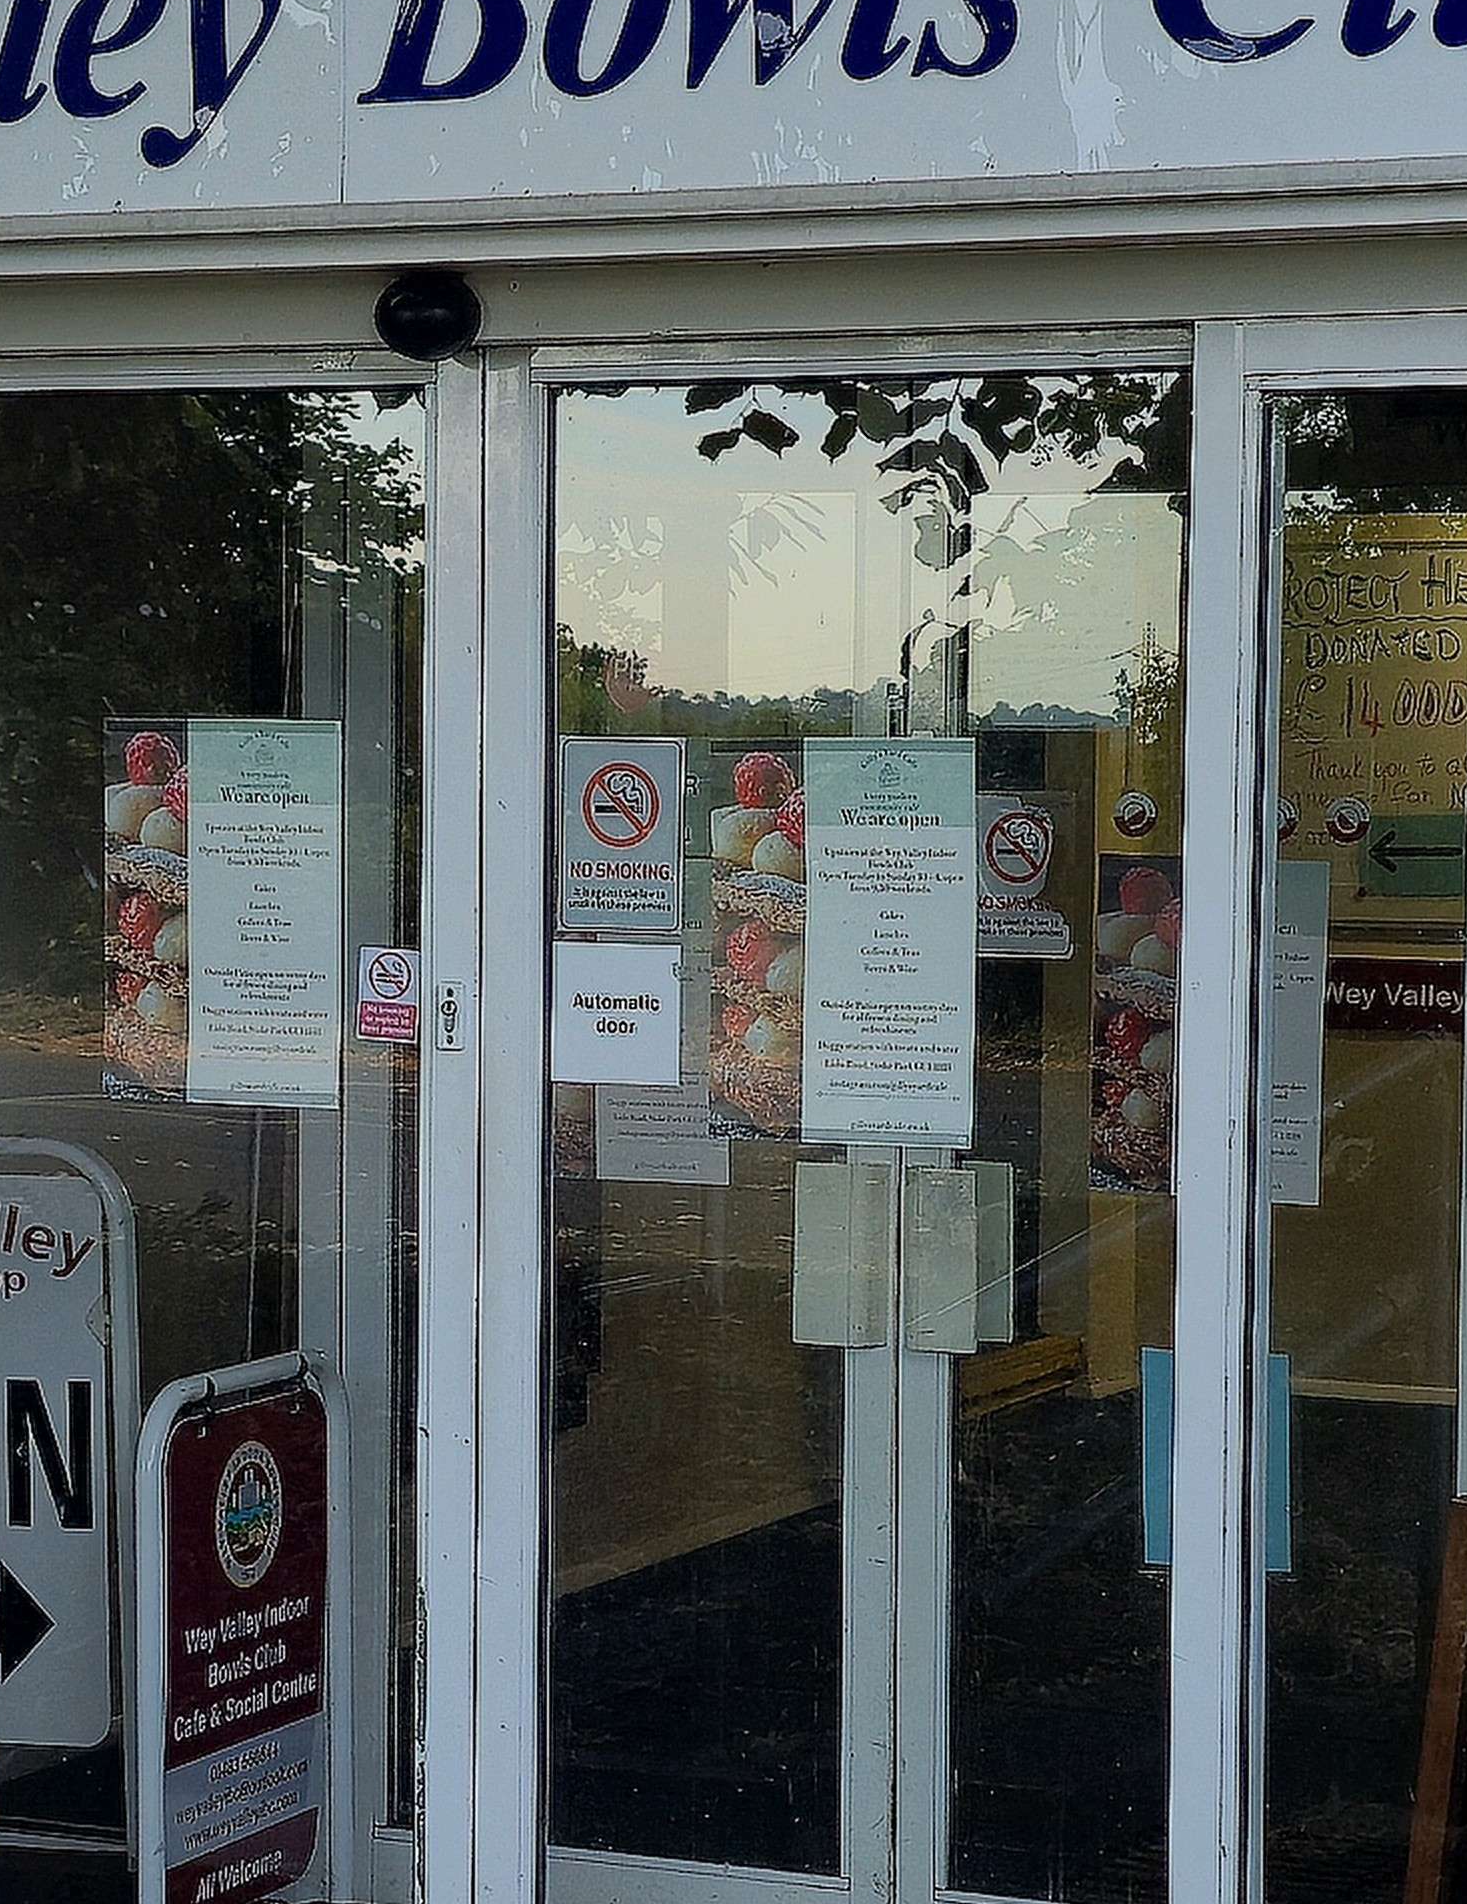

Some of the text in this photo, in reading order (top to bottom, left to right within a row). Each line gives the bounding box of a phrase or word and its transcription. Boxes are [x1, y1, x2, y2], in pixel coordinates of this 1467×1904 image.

[1304, 626, 1461, 670] DONATED
[1295, 747, 1366, 780] Thank
[272, 792, 310, 810] open
[840, 808, 866, 826] We
[898, 815, 940, 832] open
[570, 860, 593, 878] NO
[572, 992, 662, 1011] Automatic
[1384, 981, 1464, 1014] Valley
[596, 1017, 637, 1035] door
[184, 1596, 310, 1655] Wey Valley Indoor
[208, 1640, 287, 1689] Bowls Club
[173, 1671, 318, 1742] Cafe & Social Centre
[195, 1849, 284, 1904] All Welcome
